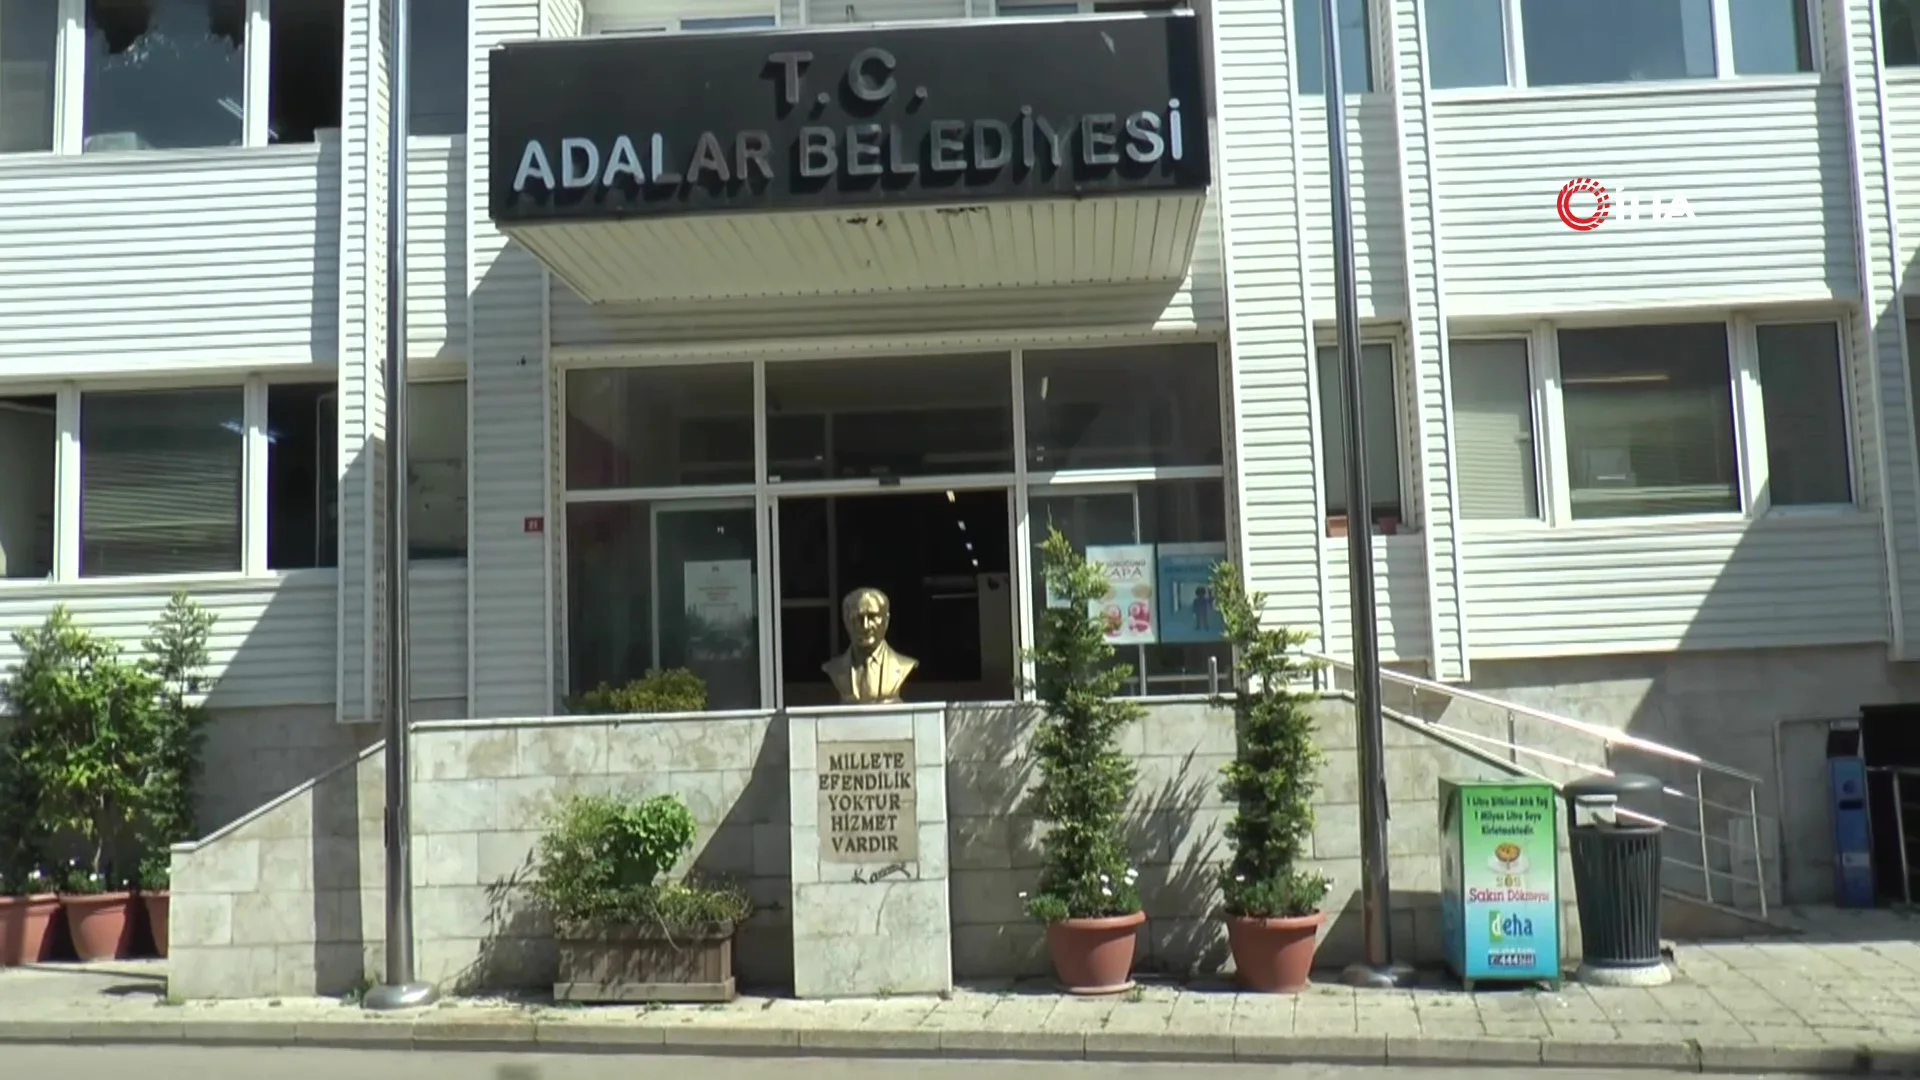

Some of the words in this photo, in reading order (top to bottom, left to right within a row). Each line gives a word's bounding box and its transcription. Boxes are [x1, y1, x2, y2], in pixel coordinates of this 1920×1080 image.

[513, 129, 775, 192] ADALAR
[799, 99, 1184, 179] BELEDİYESİ
[819, 771, 911, 791] EFENDİLİK
[827, 793, 901, 812] YOKTUR
[831, 835, 899, 853] VARDIR
[1491, 912, 1534, 937] deha
